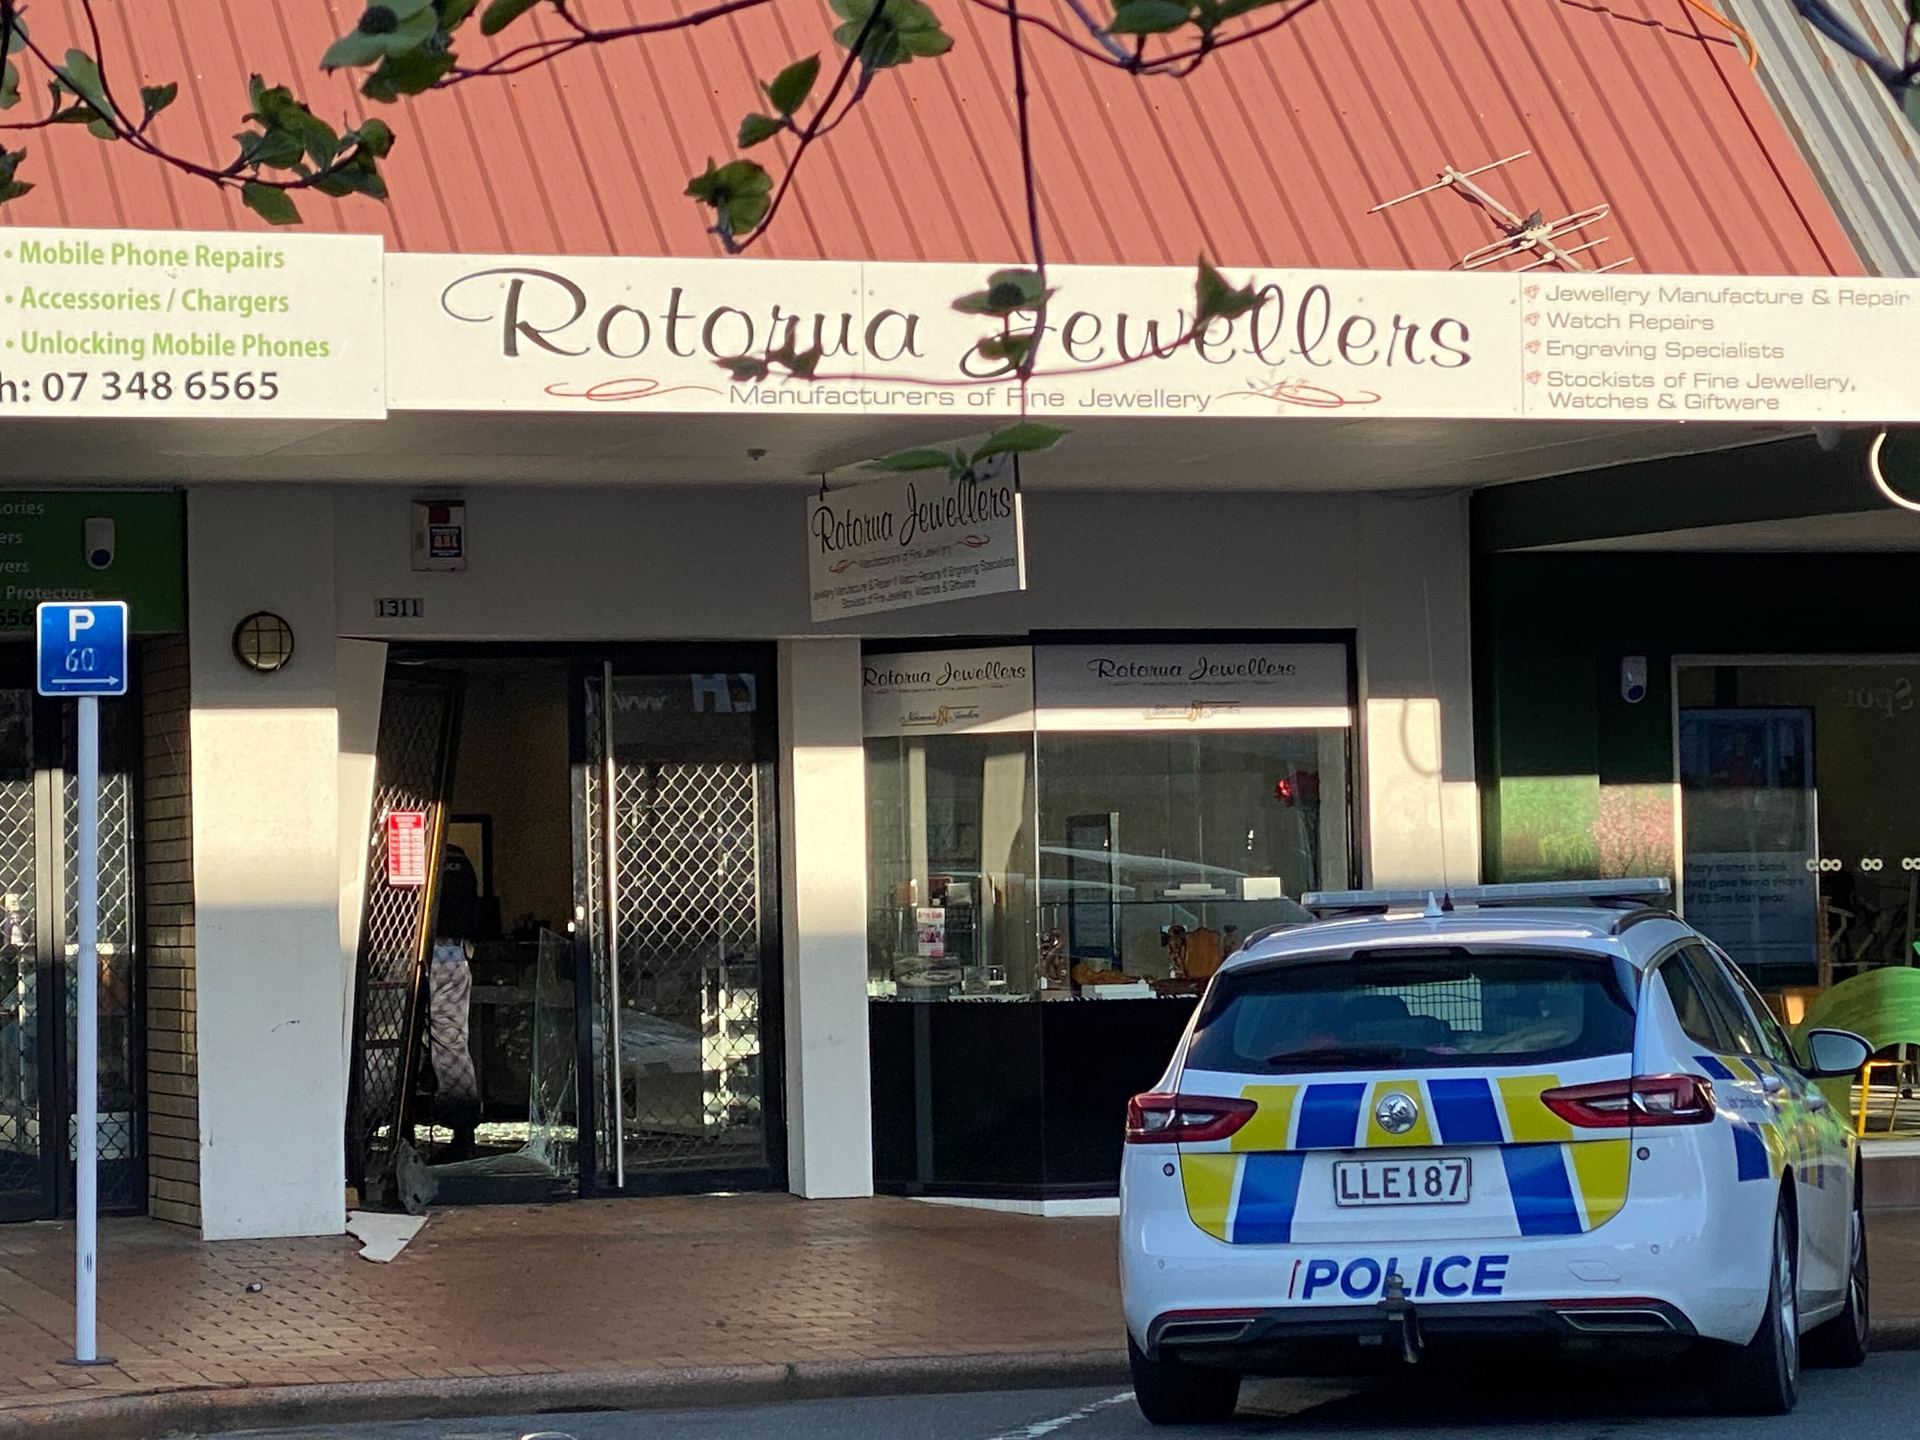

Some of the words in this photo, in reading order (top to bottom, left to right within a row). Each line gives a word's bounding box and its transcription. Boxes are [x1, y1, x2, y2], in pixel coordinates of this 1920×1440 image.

[20, 241, 104, 266] Mobile
[111, 243, 188, 267] Phone
[195, 245, 285, 272] Repairs
[20, 286, 160, 311] Accessories
[181, 288, 289, 317] Chargers
[1546, 285, 1650, 306] Jewellery
[1659, 286, 1803, 305] Manufacture
[1812, 289, 1831, 305] &
[1839, 290, 1911, 309] Repair
[441, 267, 925, 361] Rotorua
[1547, 312, 1620, 330] Watch
[1629, 313, 1714, 332] Repairs
[21, 330, 145, 360] Unlocking
[152, 333, 235, 357] Mobile
[242, 334, 330, 358] Phones
[1547, 340, 1656, 360] Engraving
[1665, 341, 1784, 361] Specialists
[42, 372, 88, 402] 07
[101, 371, 172, 401] 348
[184, 372, 279, 401] 6565
[1547, 371, 1655, 389] Stockists
[1664, 372, 1687, 388] of
[1693, 372, 1739, 389] Fine
[730, 384, 955, 406] Manufacturers
[967, 387, 996, 406] of
[1007, 387, 1064, 408] Fine
[1079, 388, 1211, 413] Jewellery
[1548, 392, 1648, 410] Watches
[1658, 393, 1675, 410] &
[1684, 394, 1779, 411] Giftware
[811, 506, 893, 553] Rotorua
[900, 481, 1011, 546] Jewellers
[6, 584, 95, 600] Protectors
[378, 600, 418, 617] 1311
[69, 608, 95, 642] P
[65, 648, 95, 672] 60
[1087, 658, 1184, 679] Rotorua
[1188, 656, 1297, 681] Jewellers
[863, 667, 931, 687] Rotorua
[936, 662, 1026, 687] Jewellers
[1341, 1165, 1463, 1200] LLE187
[1302, 1254, 1510, 1300] POLICE
